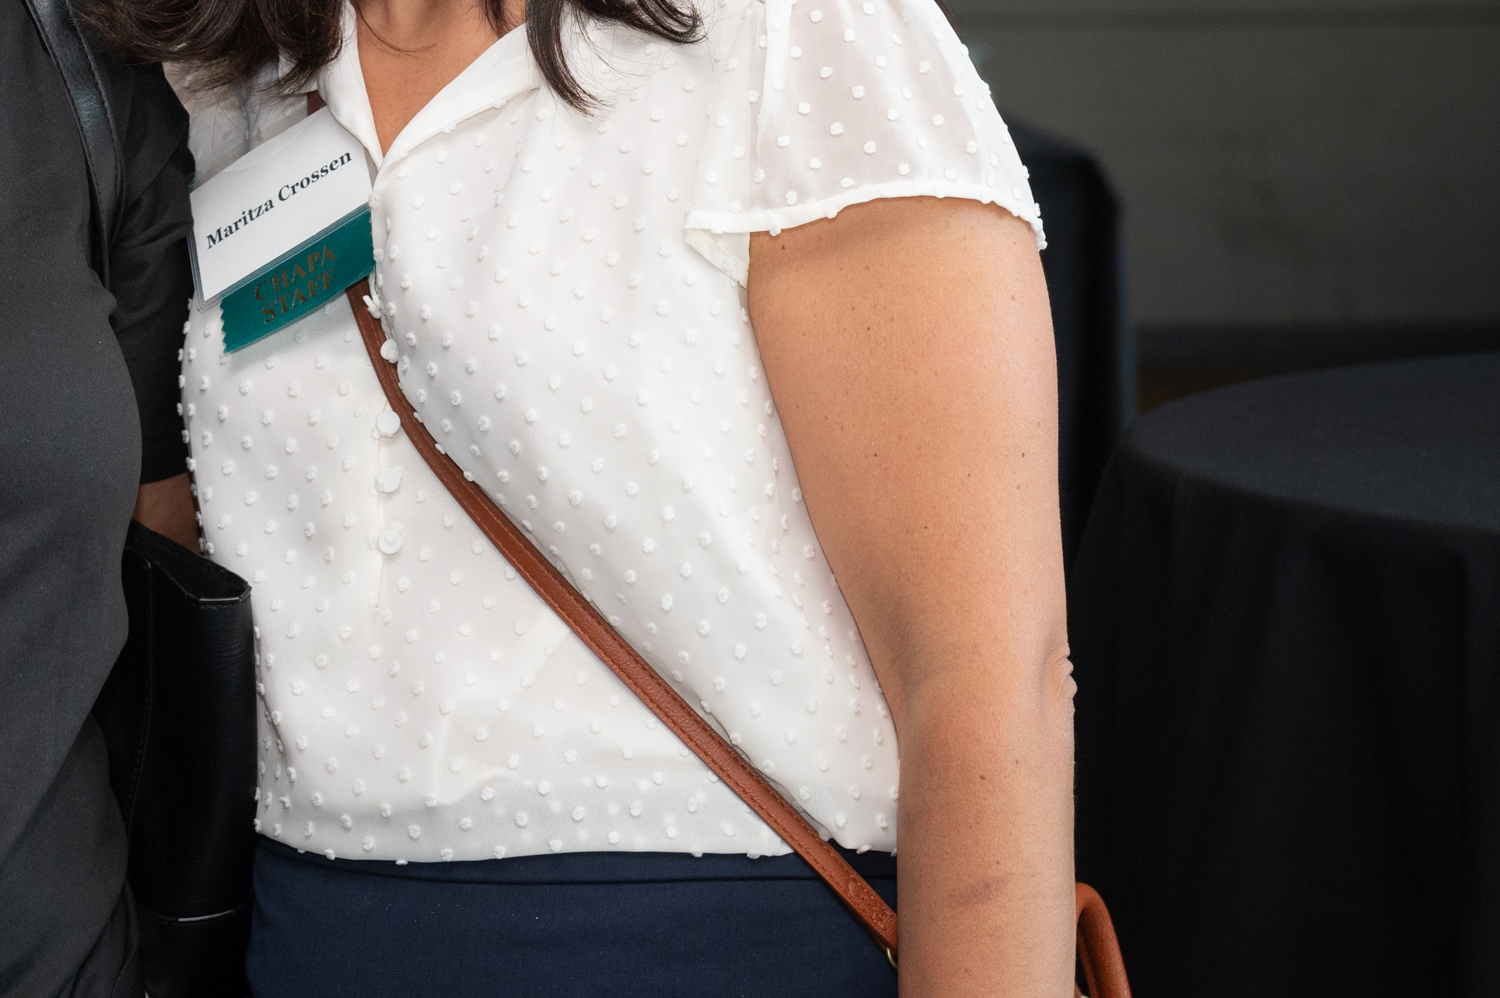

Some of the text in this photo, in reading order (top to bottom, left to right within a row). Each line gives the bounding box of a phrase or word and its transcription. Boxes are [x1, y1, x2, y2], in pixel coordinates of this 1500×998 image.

[205, 151, 353, 250] Maritza Crossen
[254, 245, 337, 303] CHAPA
[262, 267, 336, 325] STAFF
